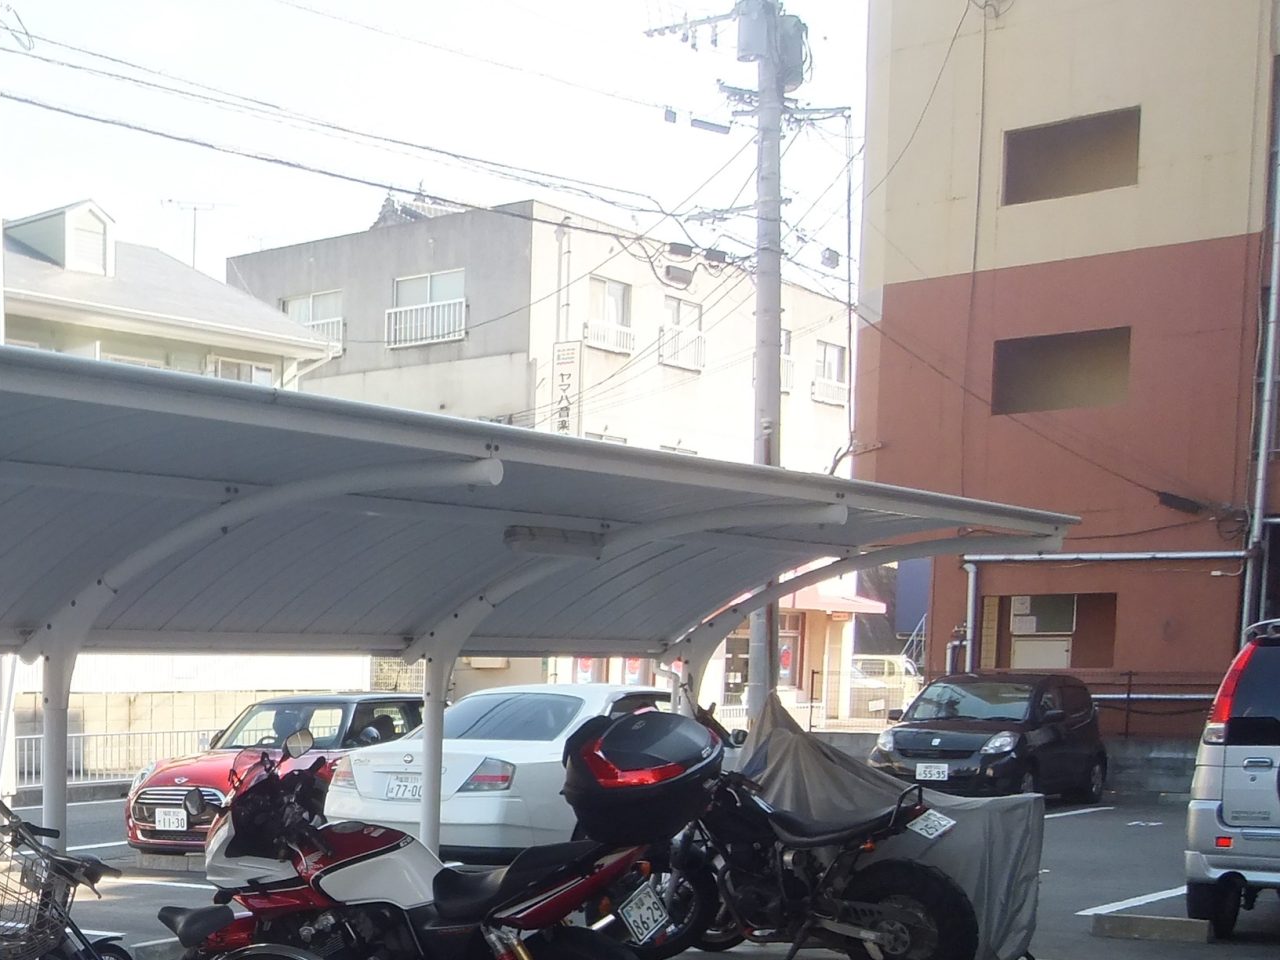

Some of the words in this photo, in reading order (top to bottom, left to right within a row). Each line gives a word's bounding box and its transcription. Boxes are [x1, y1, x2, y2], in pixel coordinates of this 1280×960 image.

[557, 372, 572, 436] ヤマハ音楽
